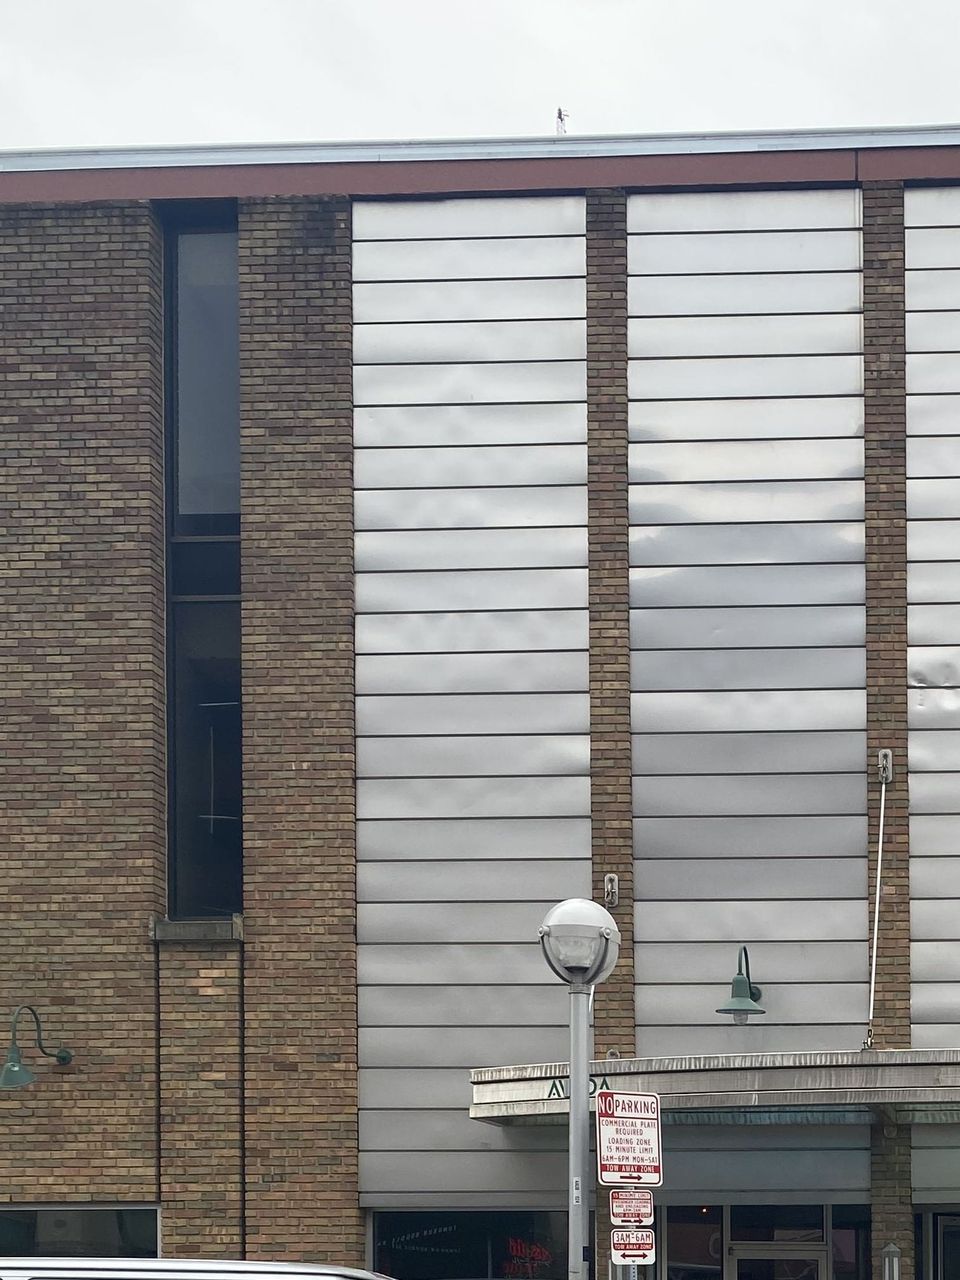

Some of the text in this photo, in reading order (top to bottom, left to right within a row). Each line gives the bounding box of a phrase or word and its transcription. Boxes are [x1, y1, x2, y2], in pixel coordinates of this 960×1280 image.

[598, 1096, 656, 1115] NO PARKING
[601, 1119, 656, 1129] COMMERCIAL PLATE
[615, 1127, 644, 1136] REQUIRED
[608, 1137, 651, 1146] LOADING ZONE
[606, 1145, 613, 1153] 15
[615, 1232, 651, 1242] 3AM-6AM
